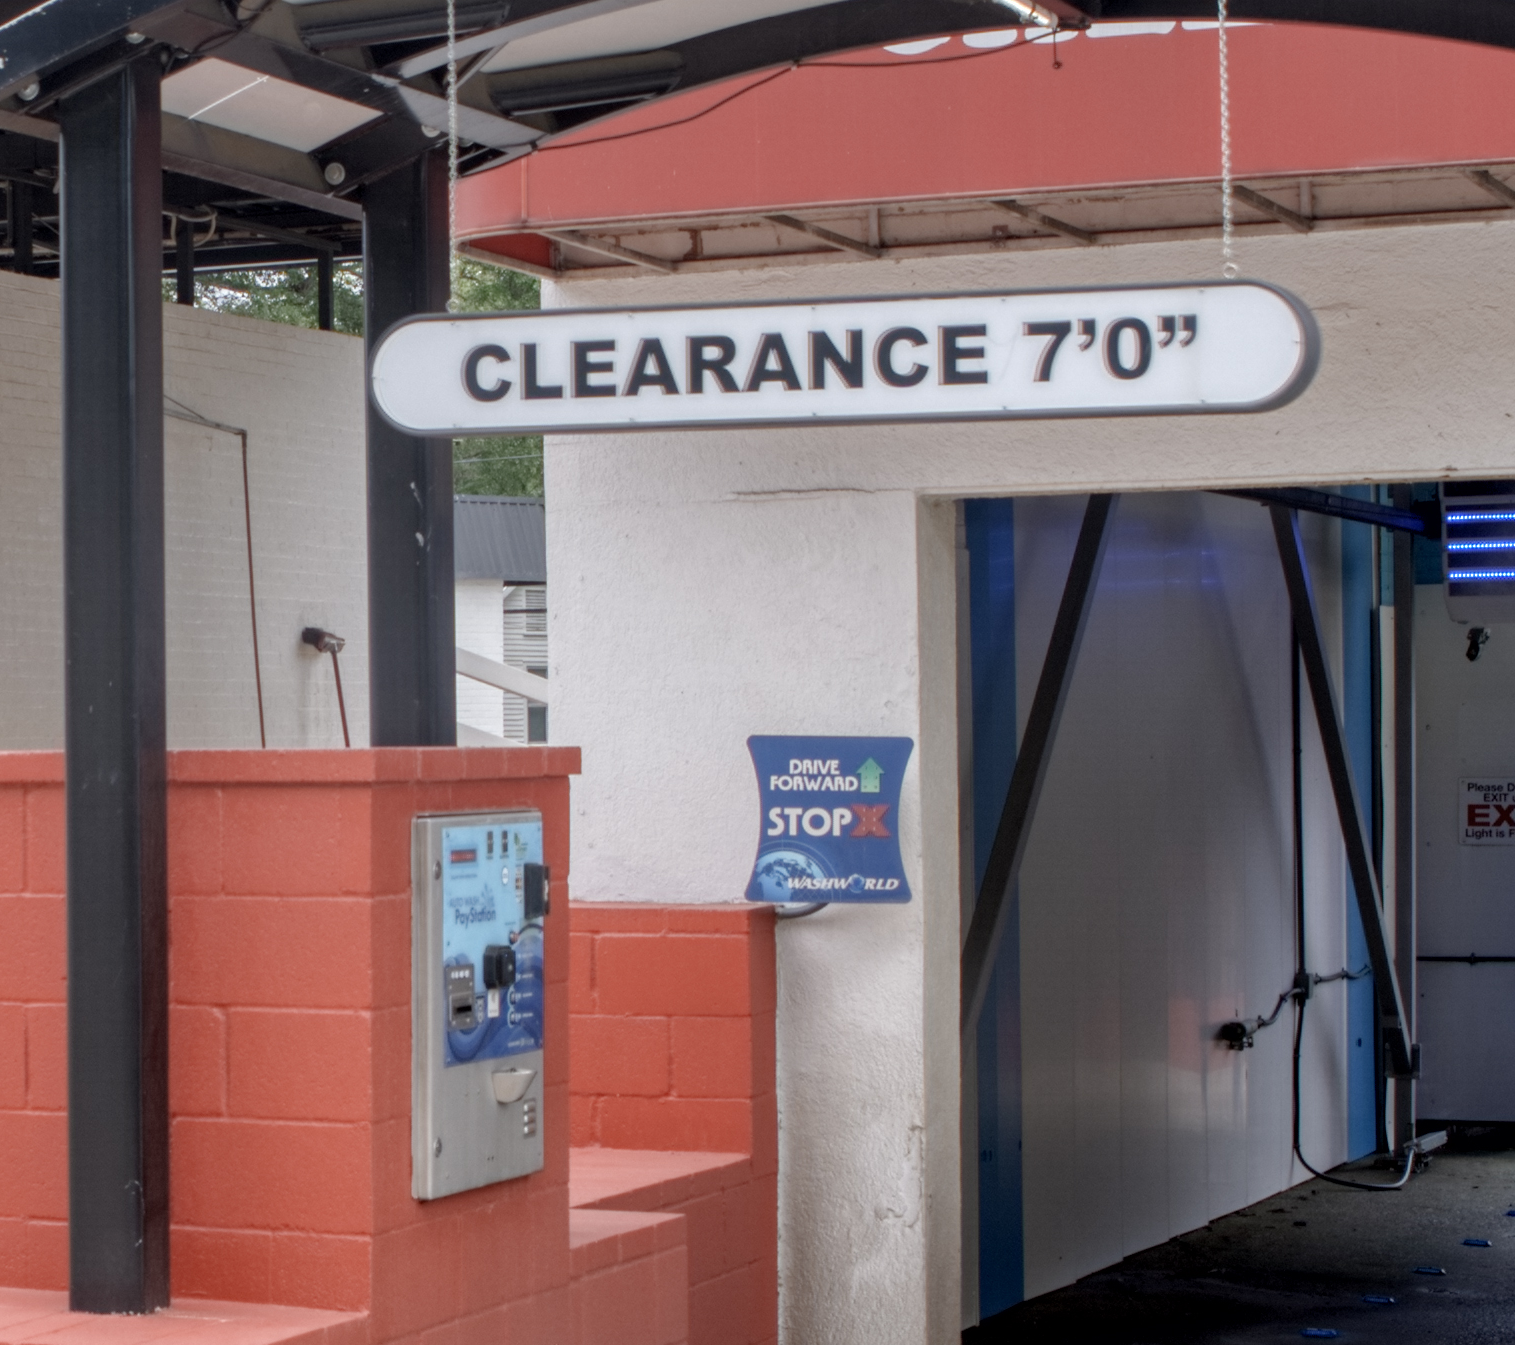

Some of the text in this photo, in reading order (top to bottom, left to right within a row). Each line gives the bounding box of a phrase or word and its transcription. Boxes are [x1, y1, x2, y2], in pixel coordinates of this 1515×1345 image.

[461, 323, 989, 402] CLEARANCE
[789, 759, 840, 775] DRIVE
[769, 776, 858, 791] FORWARD
[1467, 782, 1503, 792] Please
[1483, 793, 1508, 802] EXIT
[767, 807, 852, 836] STOP
[1465, 829, 1492, 840] Light
[1496, 829, 1505, 838] is
[455, 906, 496, 929] PayStation
